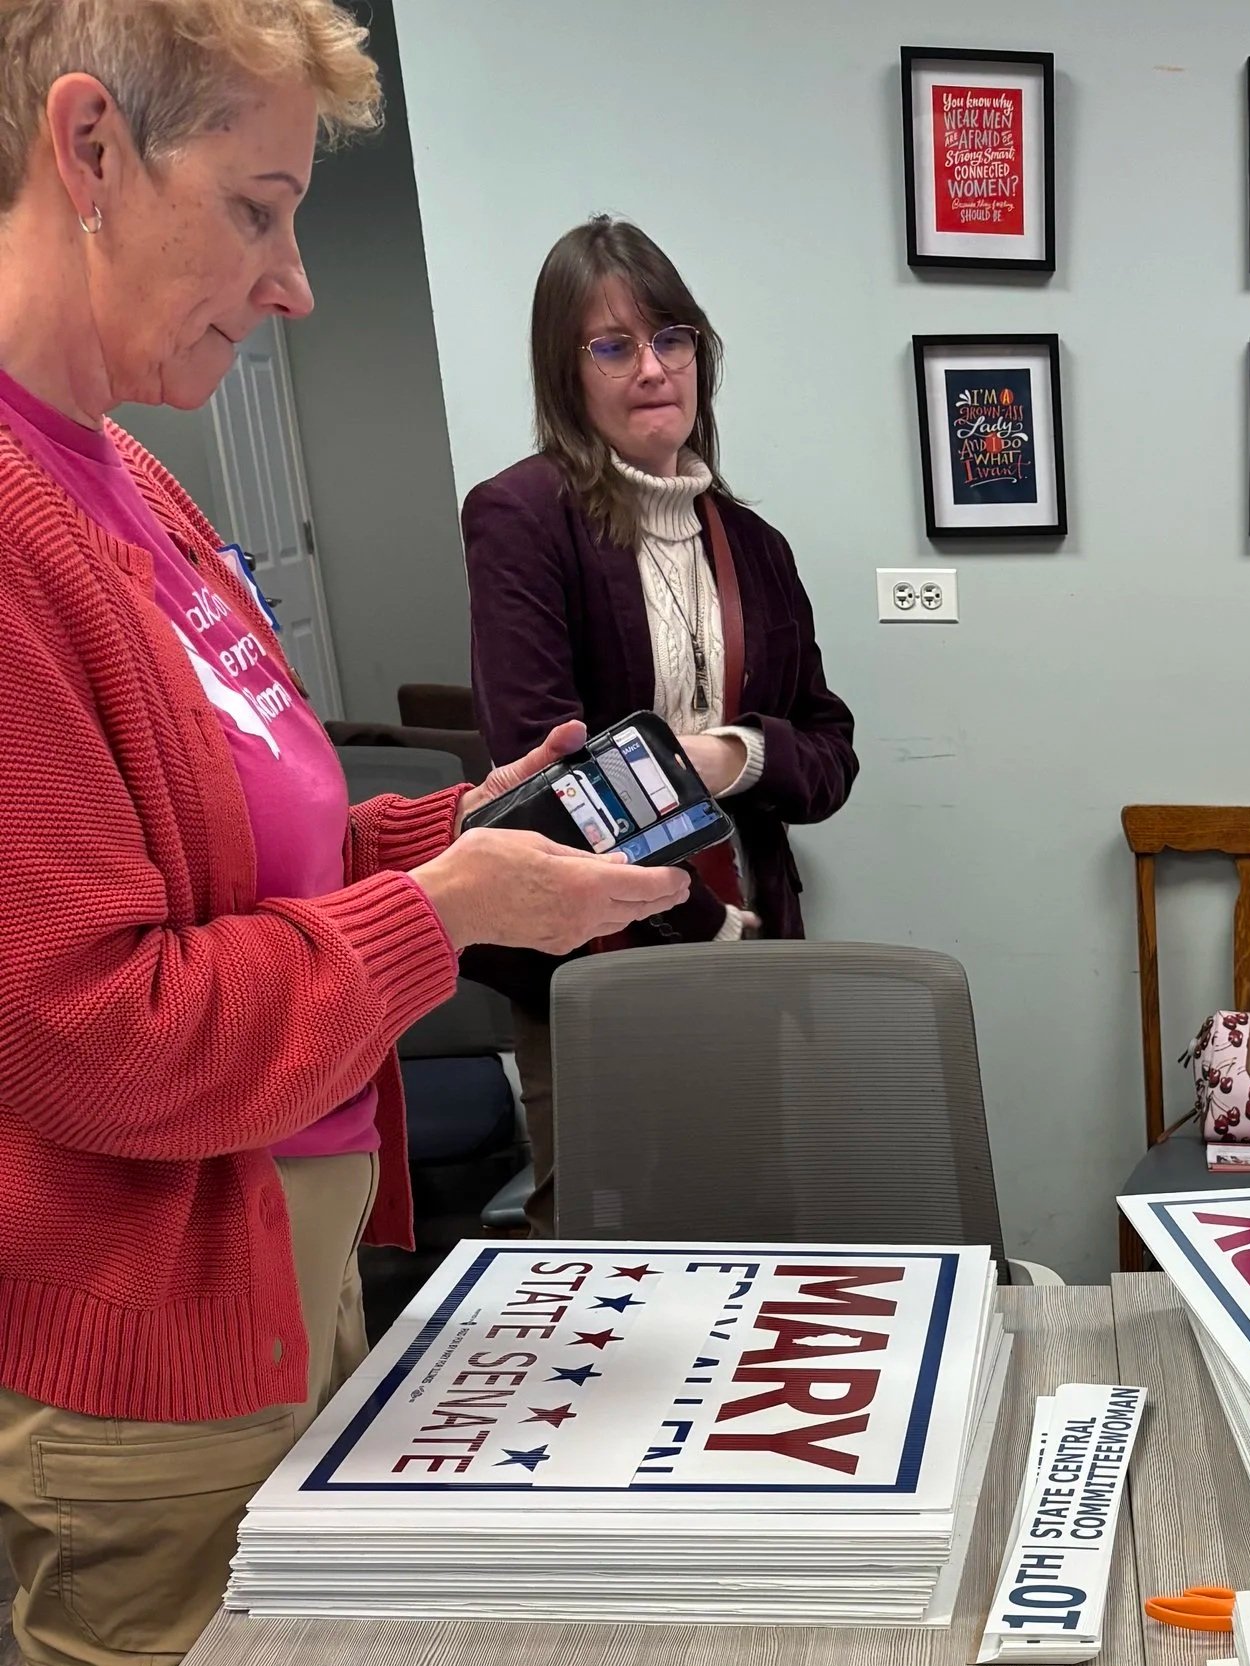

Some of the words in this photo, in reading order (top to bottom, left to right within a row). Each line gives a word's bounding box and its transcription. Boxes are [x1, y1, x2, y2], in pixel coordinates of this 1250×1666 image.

[943, 93, 963, 111] You
[966, 91, 991, 108] know
[993, 93, 1014, 116] why
[944, 109, 979, 130] WEAK
[983, 109, 1013, 129] MEN
[945, 132, 957, 147] ARE
[958, 129, 1000, 150] AFRAID
[955, 162, 1010, 180] CONNECTED
[948, 175, 1018, 198] WOMEN?
[961, 208, 990, 223] SHOULD
[972, 389, 997, 405] I'M
[1002, 389, 1011, 404] A
[955, 416, 1016, 439] Lady
[959, 439, 986, 460] AND
[1002, 439, 1021, 448] DO
[975, 451, 1015, 465] WHAT
[962, 460, 978, 484] I
[484, 1261, 593, 1341] STATE
[703, 1264, 907, 1475] MARY
[391, 1352, 539, 1474] SENATE
[1048, 1416, 1097, 1483] CENTRAL
[1070, 1387, 1140, 1540] COMMITTEEWOMAN
[1030, 1488, 1075, 1539] STATE
[1002, 1554, 1088, 1630] 10TH
